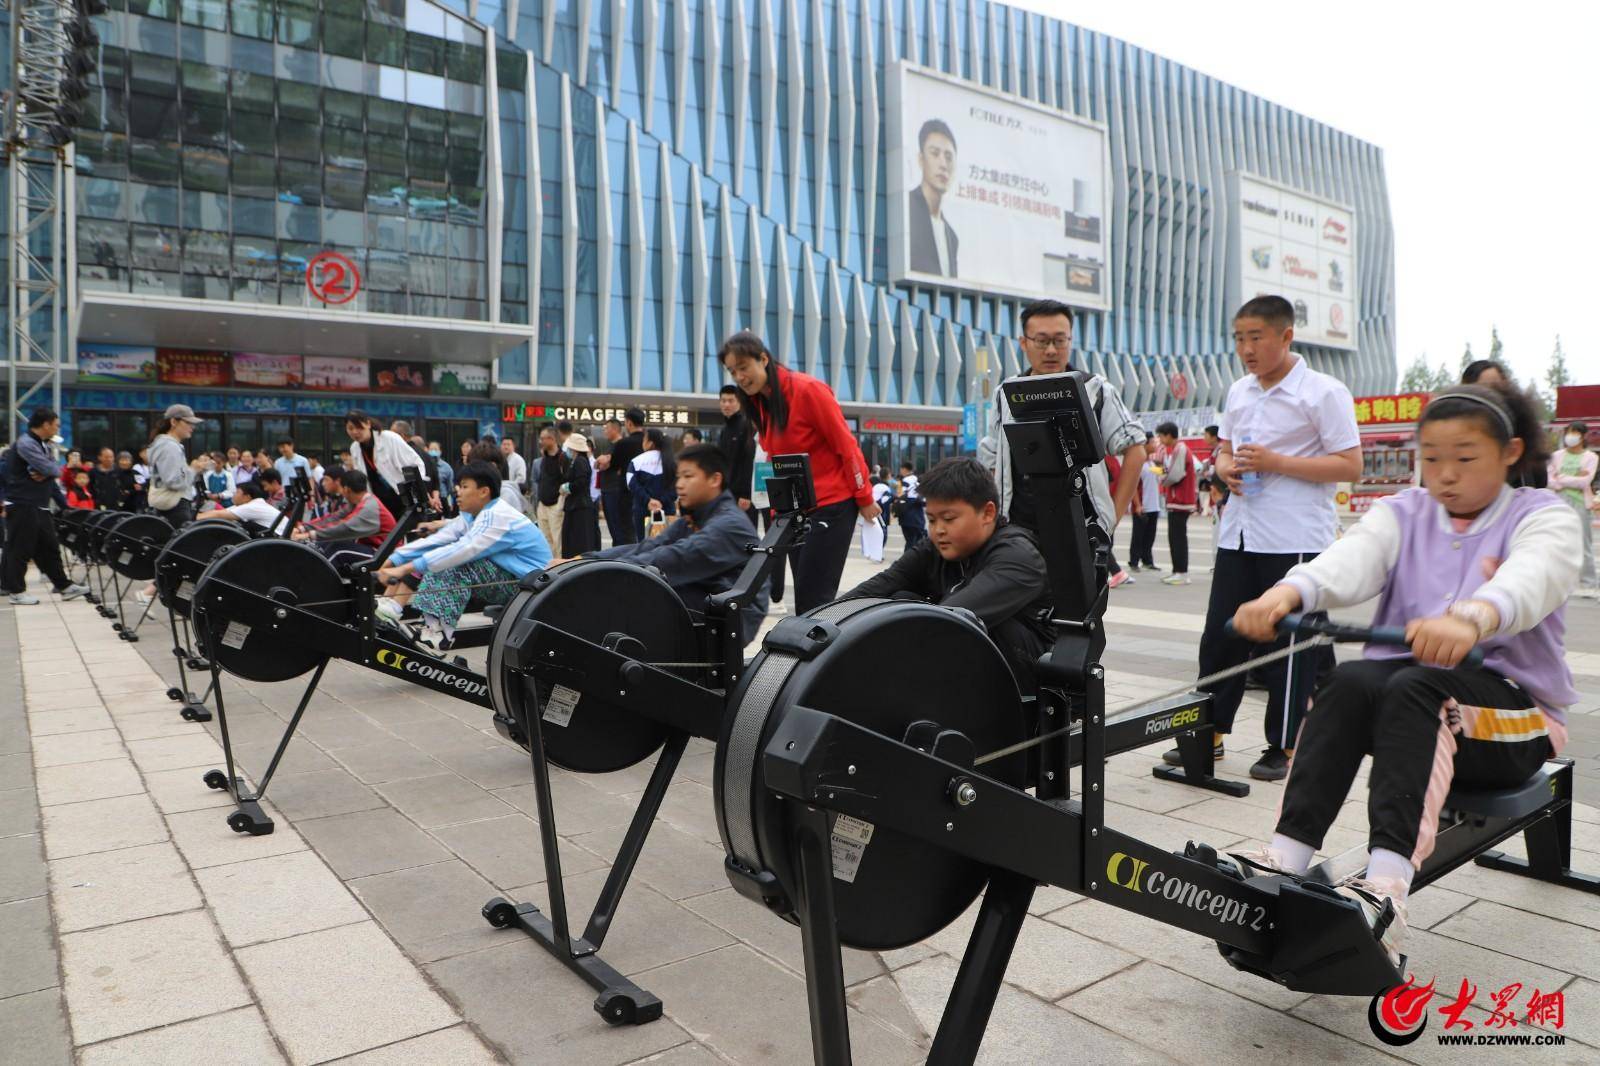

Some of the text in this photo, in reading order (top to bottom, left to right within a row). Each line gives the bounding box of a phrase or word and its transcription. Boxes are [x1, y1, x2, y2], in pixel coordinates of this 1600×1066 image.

[321, 262, 346, 295] 2
[1025, 390, 1073, 401] concept 2
[643, 409, 689, 424] 王茶姬
[405, 661, 489, 697] concept
[1146, 870, 1267, 932] concept 2
